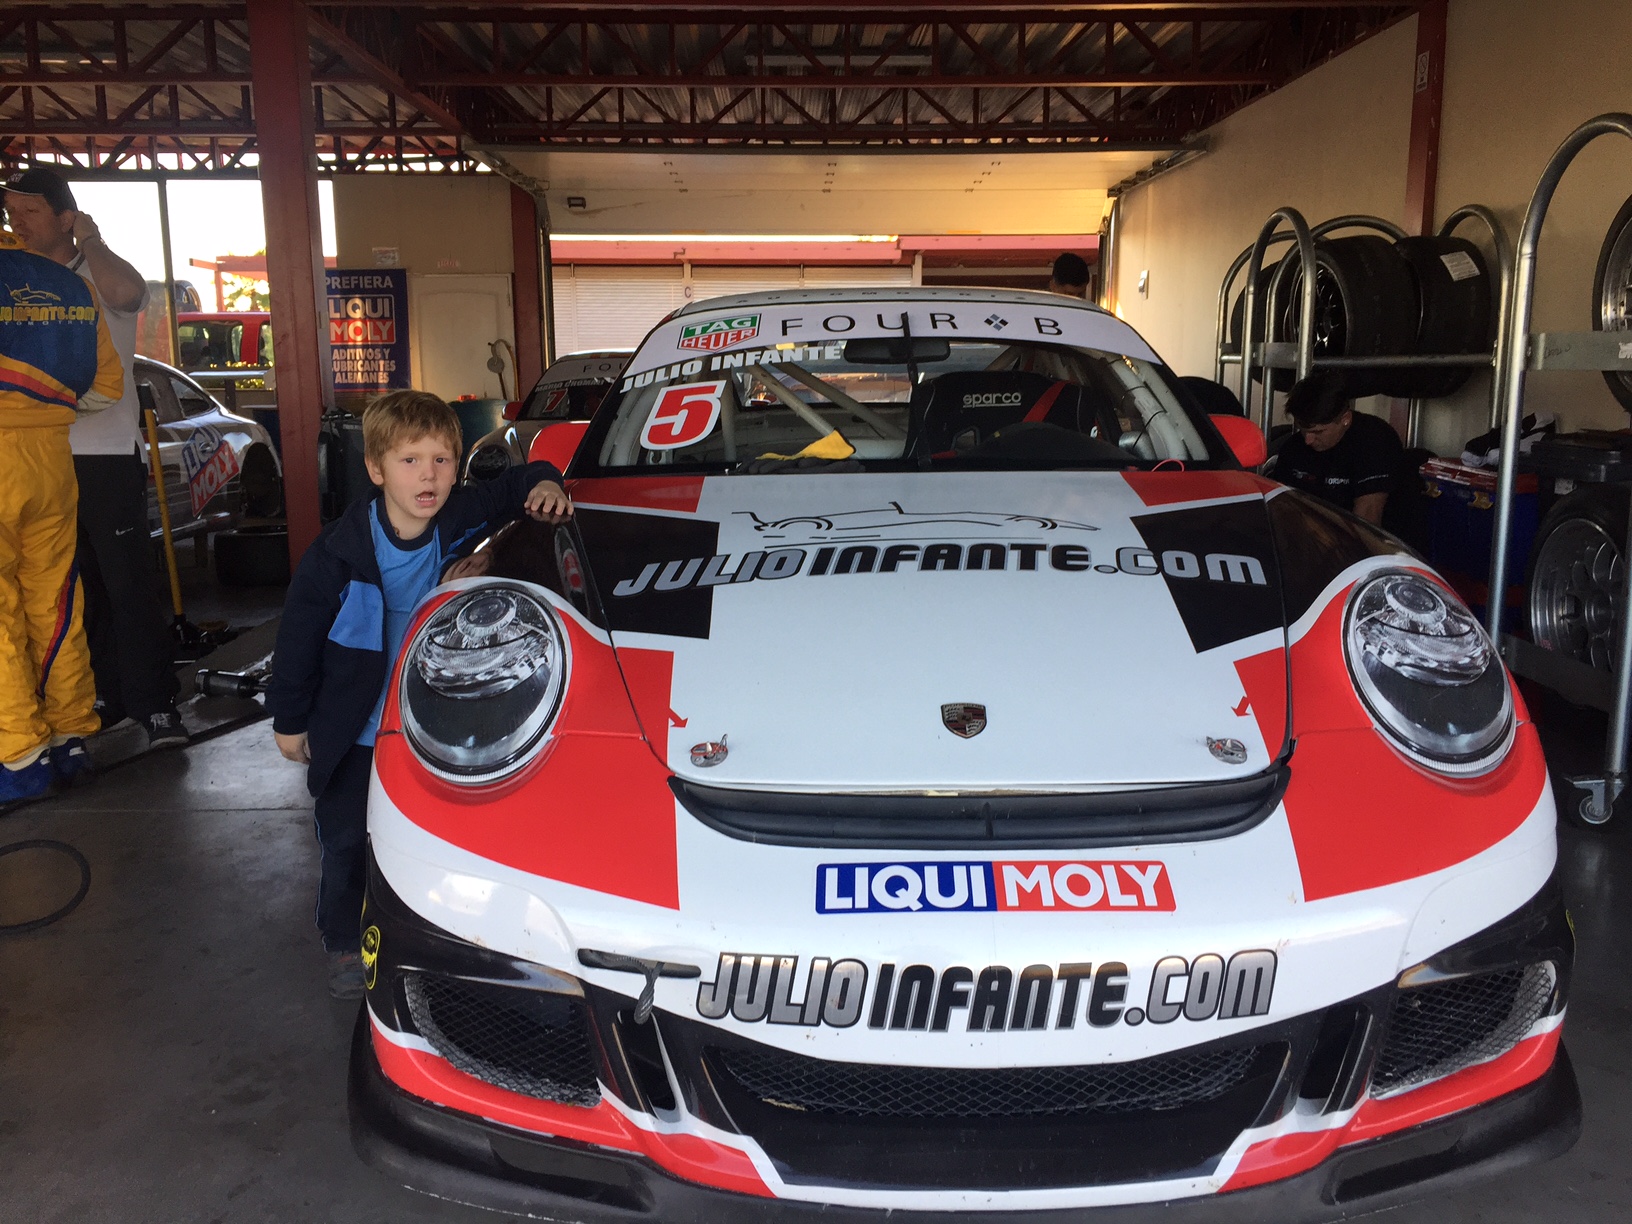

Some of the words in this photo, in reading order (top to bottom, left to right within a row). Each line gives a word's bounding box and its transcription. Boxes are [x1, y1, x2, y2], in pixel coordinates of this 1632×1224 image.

[329, 297, 391, 319] LIQUI
[330, 320, 392, 342] MOLY
[689, 317, 752, 336] TAG
[781, 312, 959, 337] FOUR
[1034, 316, 1063, 336] B
[683, 329, 753, 350] HEUER
[332, 348, 381, 360] ADITIVOS
[384, 348, 391, 360] Y
[332, 360, 396, 373] UBRICANTES
[620, 360, 703, 394] JULIO
[711, 344, 841, 370] INFANTE
[335, 372, 389, 384] ALEMANES
[543, 388, 568, 412] 7
[962, 391, 1022, 408] sparco
[645, 383, 720, 446] 5
[184, 423, 224, 479] LIQUI
[192, 444, 233, 510] MOLY
[824, 863, 988, 911] LIQUI
[1001, 862, 1163, 908] MOLY
